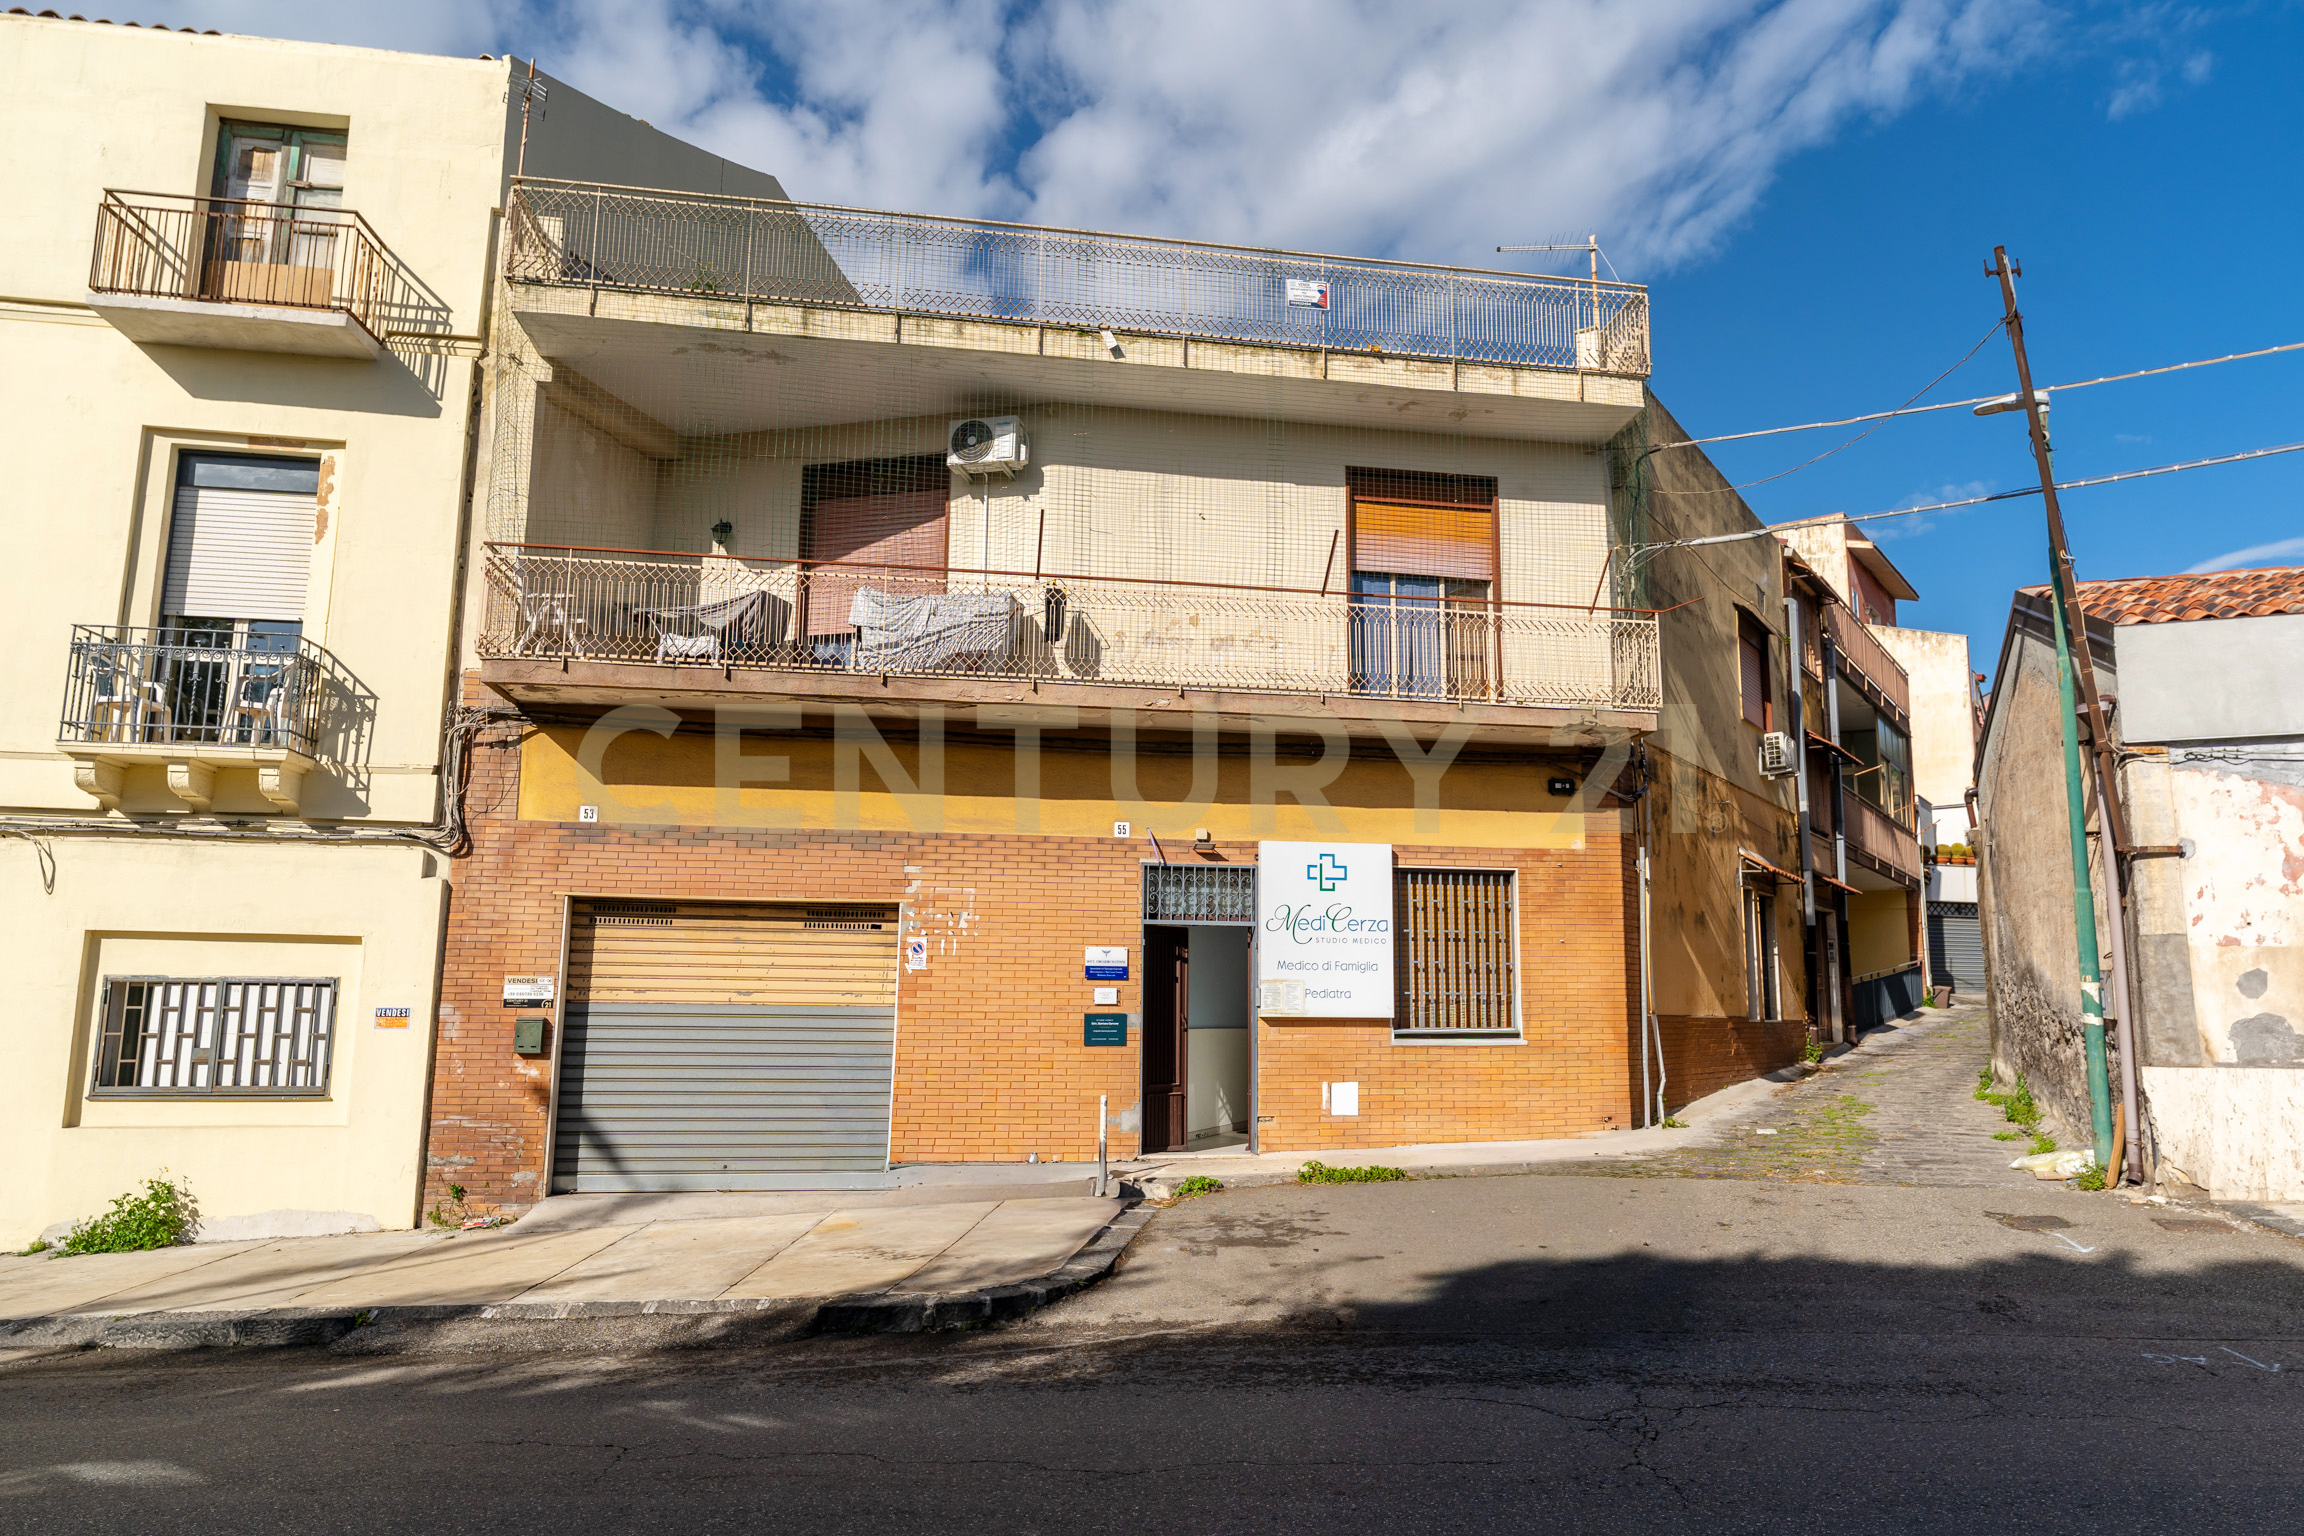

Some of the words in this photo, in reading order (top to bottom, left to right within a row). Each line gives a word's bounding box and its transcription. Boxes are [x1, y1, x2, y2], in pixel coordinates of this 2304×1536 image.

[584, 809, 594, 819] 53
[1117, 824, 1127, 835] 55
[1277, 960, 1319, 971] Medico
[1321, 960, 1332, 971] di
[1334, 960, 1379, 973] Famiglia
[1304, 988, 1352, 999] Pediatra
